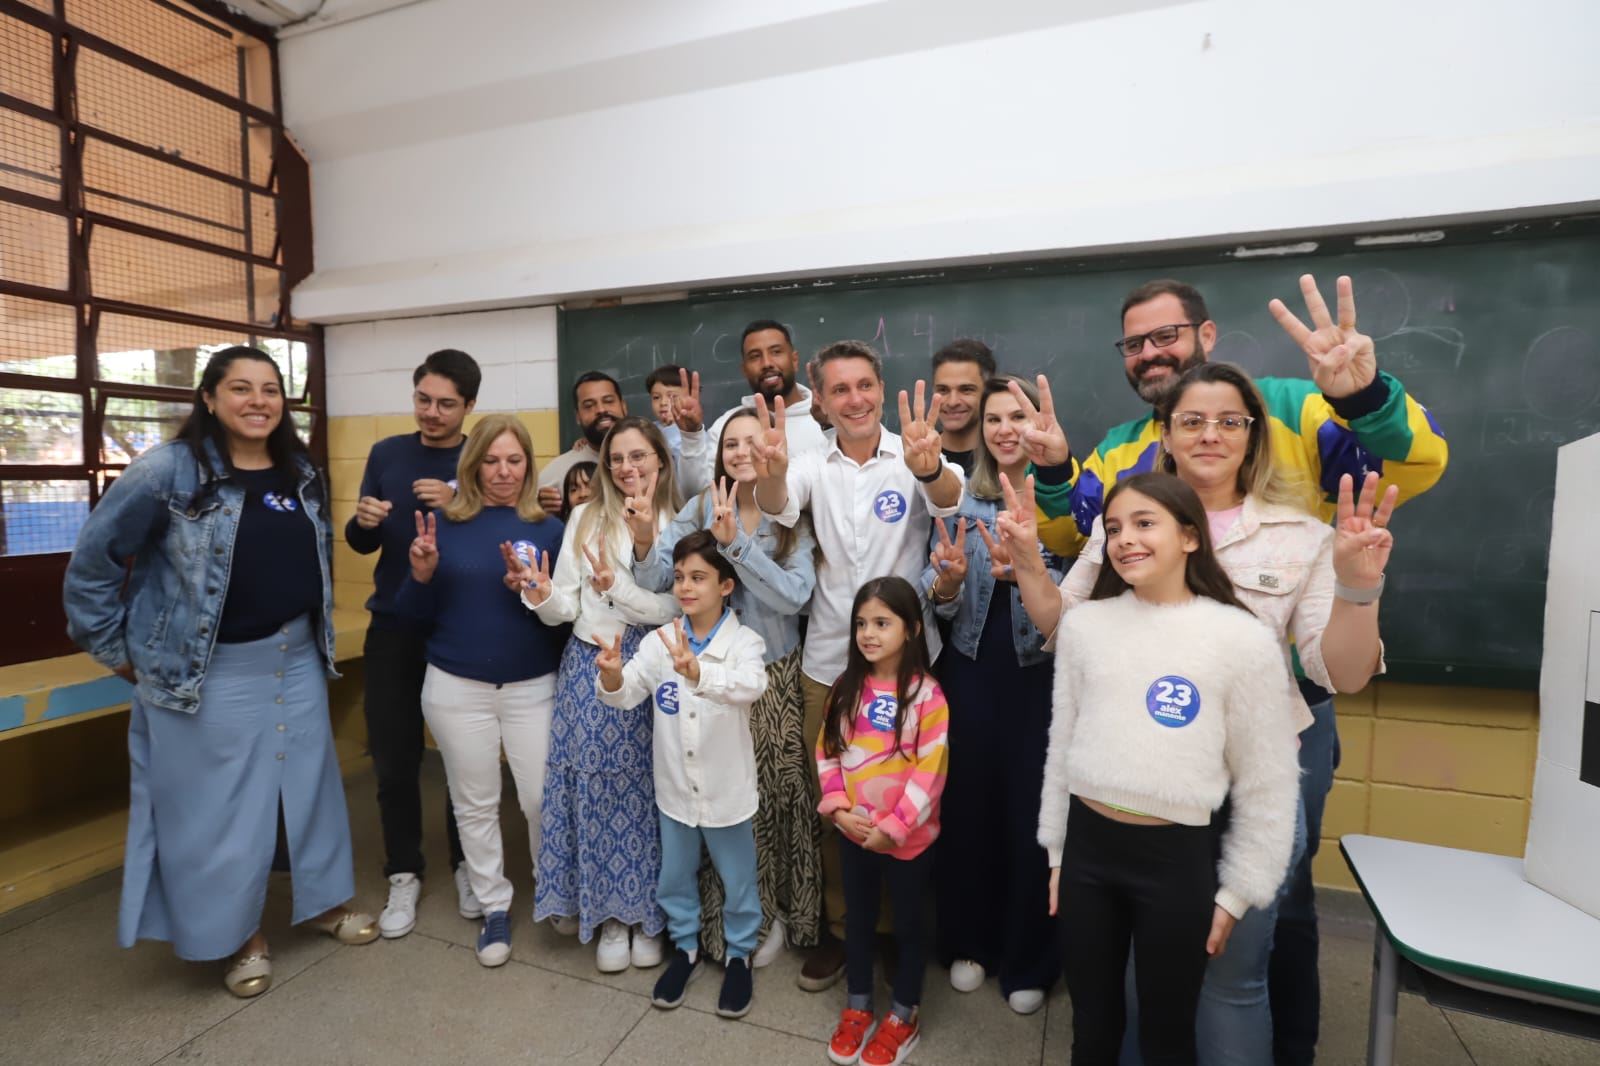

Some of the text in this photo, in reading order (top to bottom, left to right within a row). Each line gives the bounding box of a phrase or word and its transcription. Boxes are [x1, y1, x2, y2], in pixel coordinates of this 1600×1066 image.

[878, 493, 900, 511] 23
[1156, 681, 1192, 707] 23
[873, 698, 898, 718] 23
[1160, 703, 1183, 715] alex
